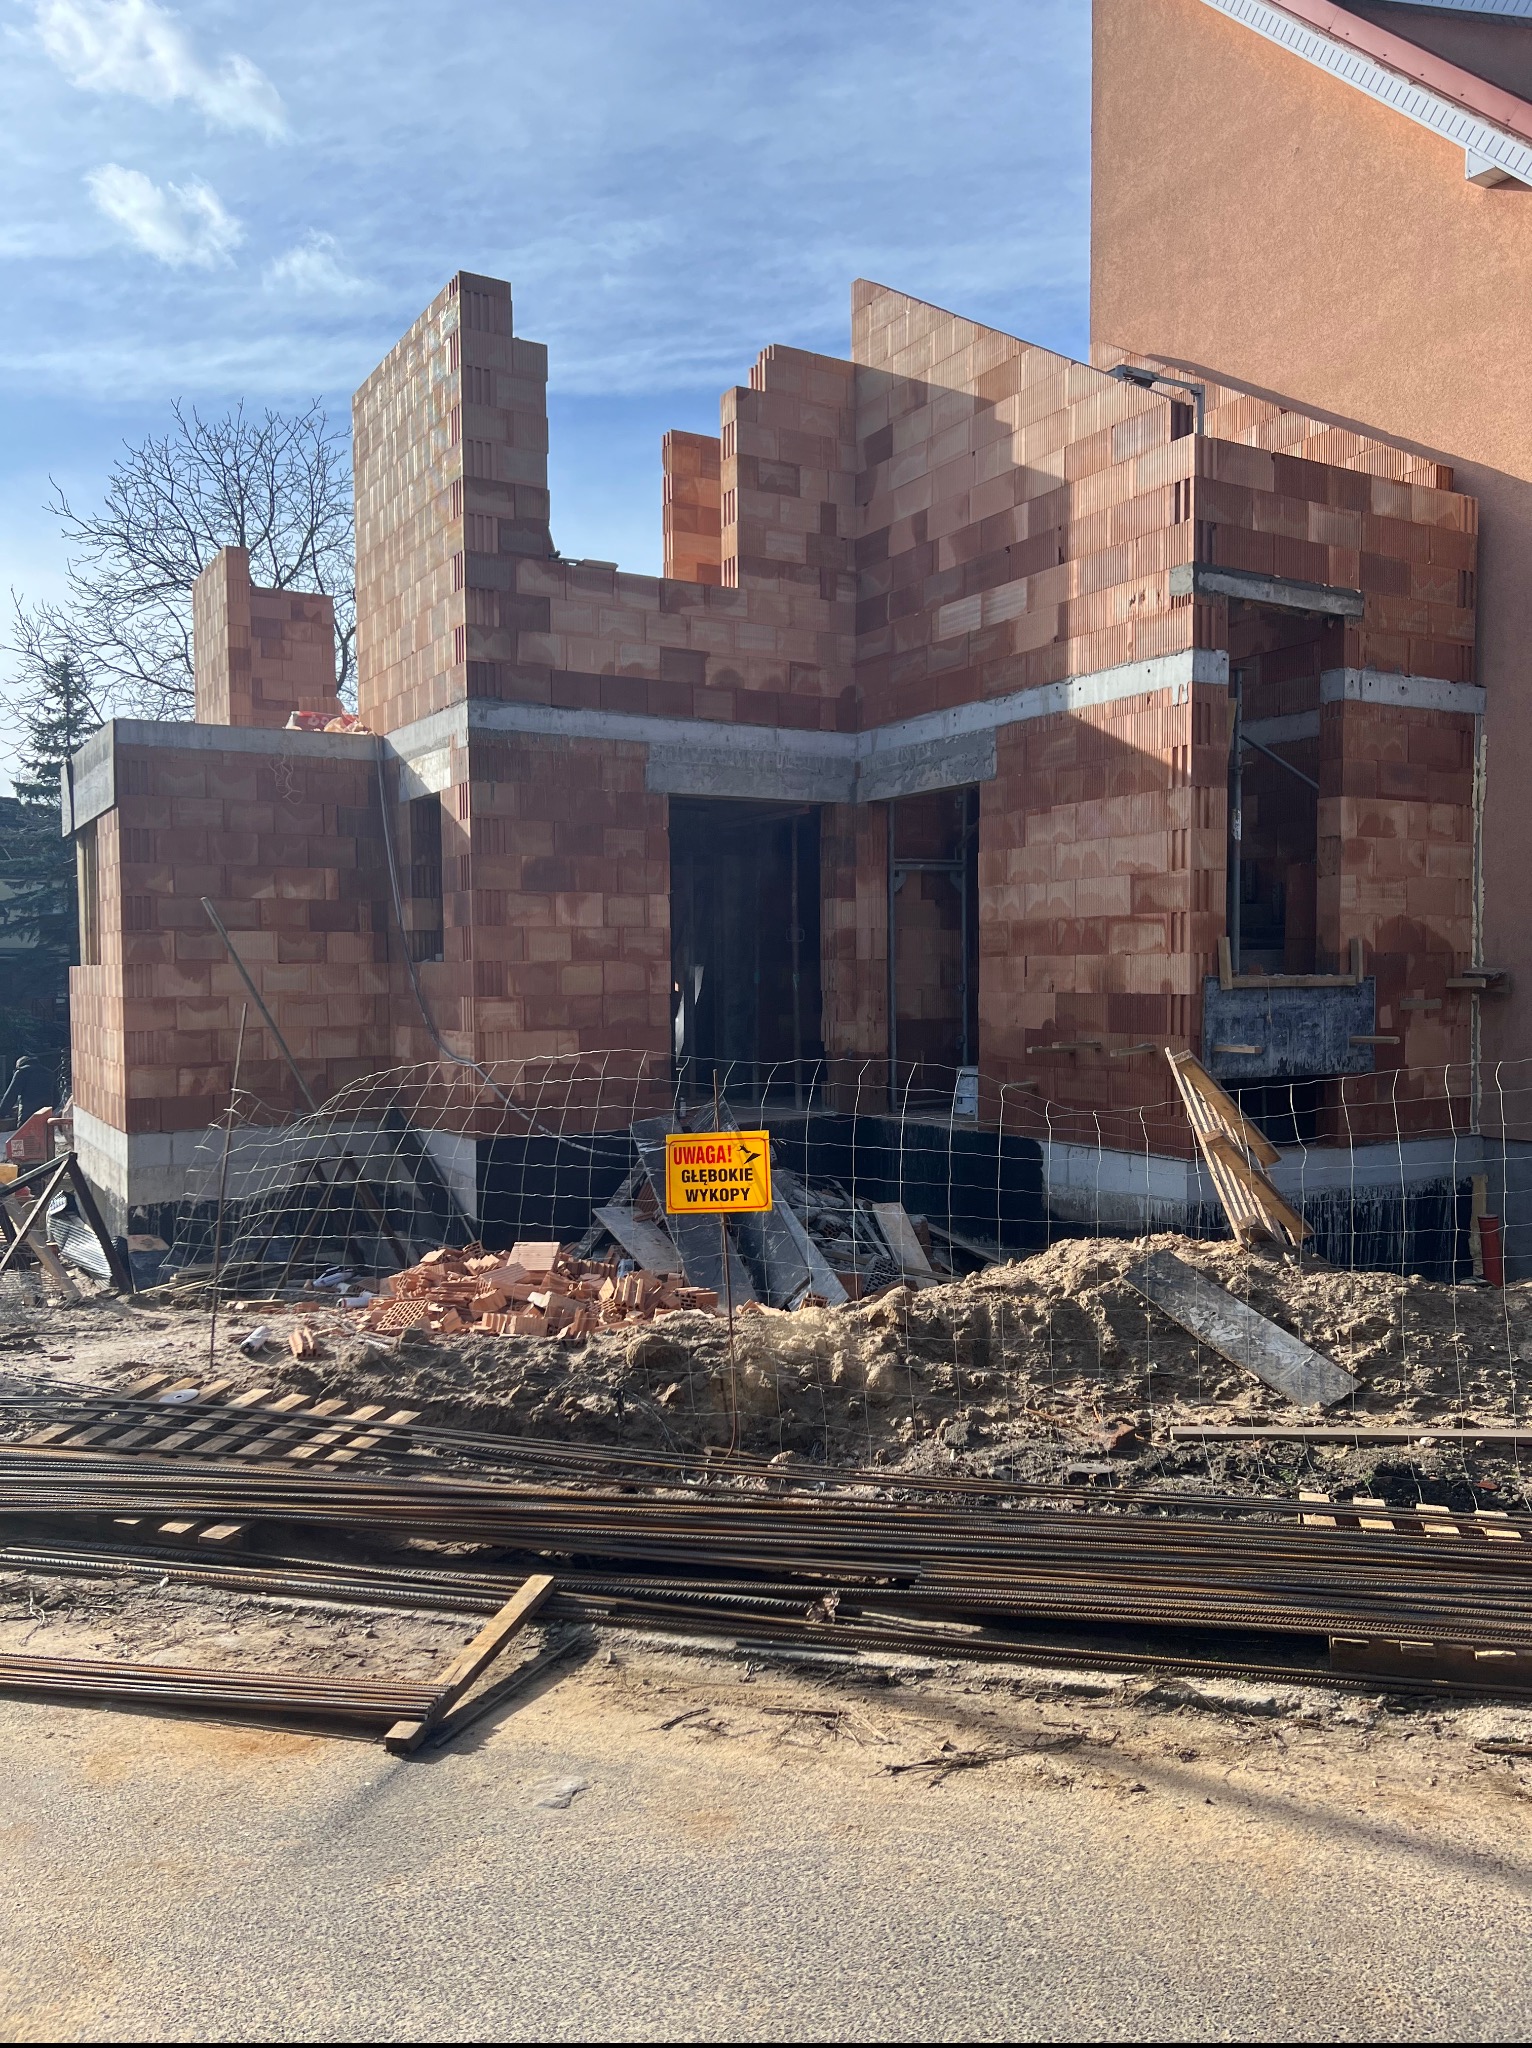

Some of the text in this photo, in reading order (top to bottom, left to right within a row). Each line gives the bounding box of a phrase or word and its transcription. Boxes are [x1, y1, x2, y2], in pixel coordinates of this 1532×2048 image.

[673, 1145, 732, 1165] UWAGA!
[681, 1168, 753, 1185] GŁĘBOKIE
[685, 1188, 750, 1202] WYKOPY
